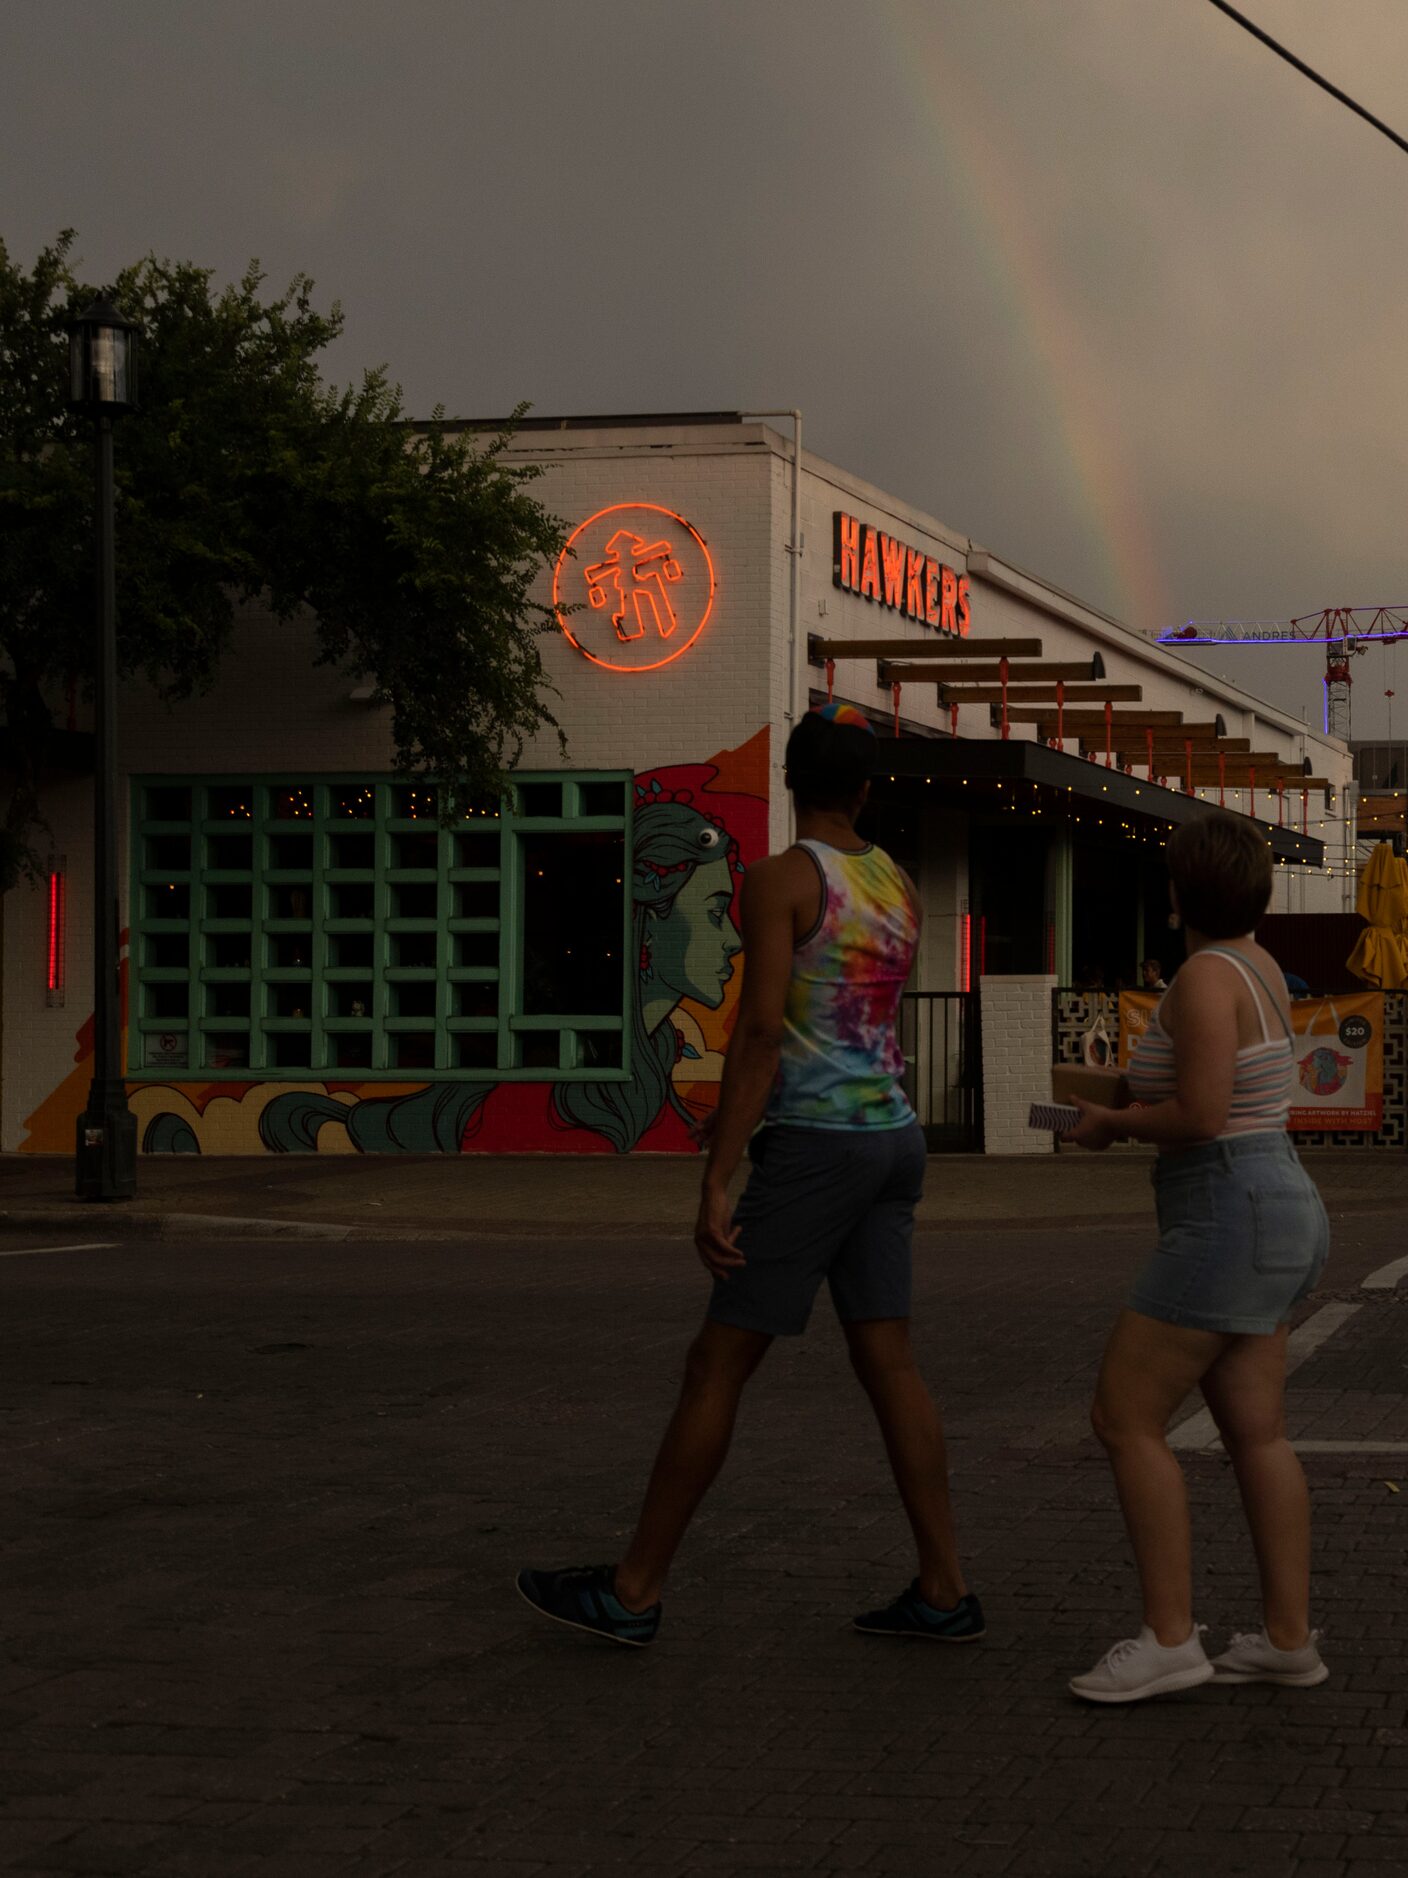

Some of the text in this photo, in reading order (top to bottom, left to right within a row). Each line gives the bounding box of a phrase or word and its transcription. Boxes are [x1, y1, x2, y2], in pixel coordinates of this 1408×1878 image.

[833, 511, 971, 640] HAWKERS
[1243, 631, 1297, 641] ANDRES
[1345, 1026, 1365, 1036] $20
